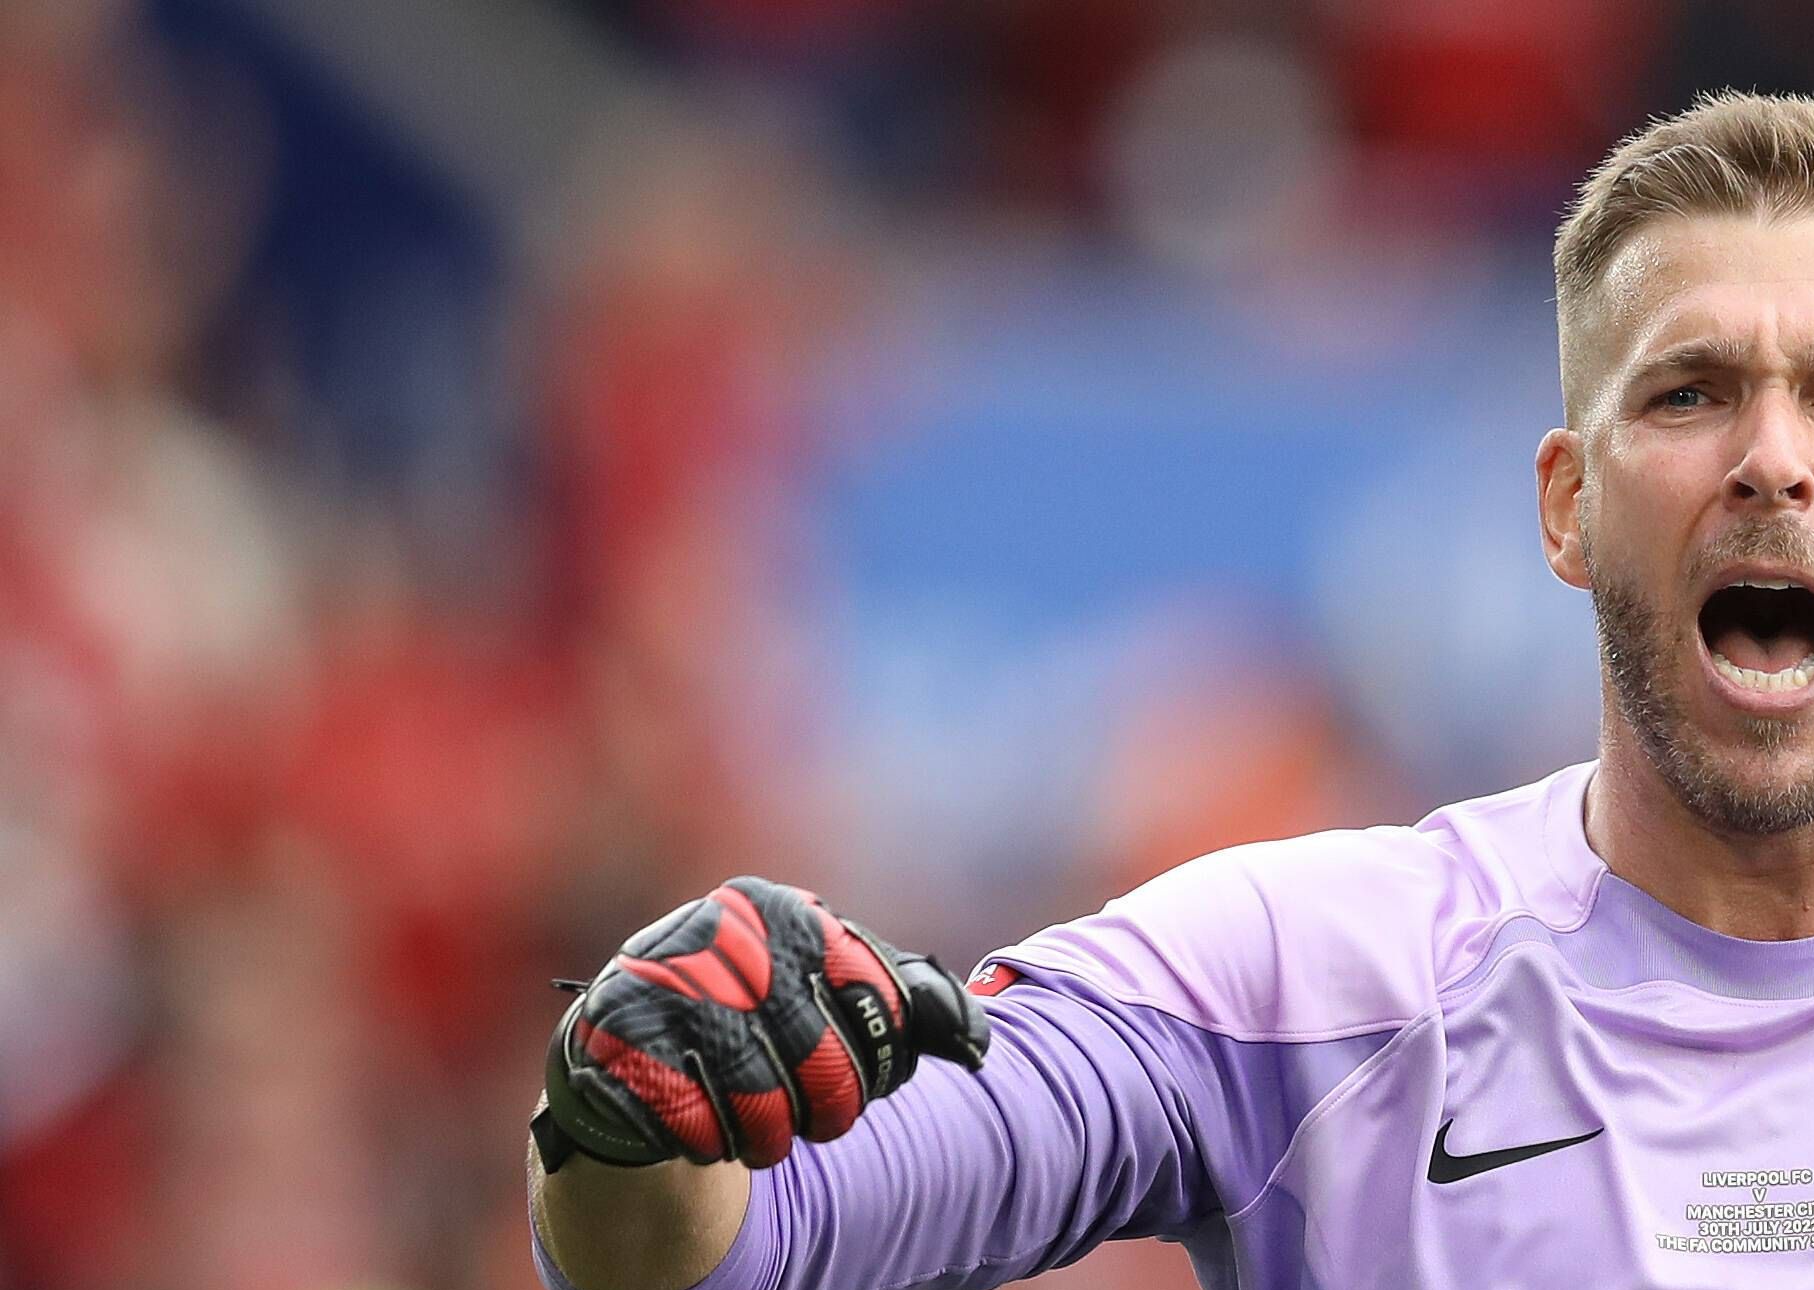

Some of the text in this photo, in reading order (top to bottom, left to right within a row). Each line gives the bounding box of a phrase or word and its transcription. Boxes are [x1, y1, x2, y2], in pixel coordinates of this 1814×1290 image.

[1702, 1169, 1813, 1187] LIVERPOOL FC
[1686, 1203, 1794, 1220] MANCHESTER
[1699, 1221, 1740, 1236] 30TH
[1742, 1220, 1781, 1236] JULY
[1656, 1234, 1693, 1251] THE
[1688, 1238, 1710, 1253] FA
[1710, 1235, 1808, 1253] COMMUNITY
